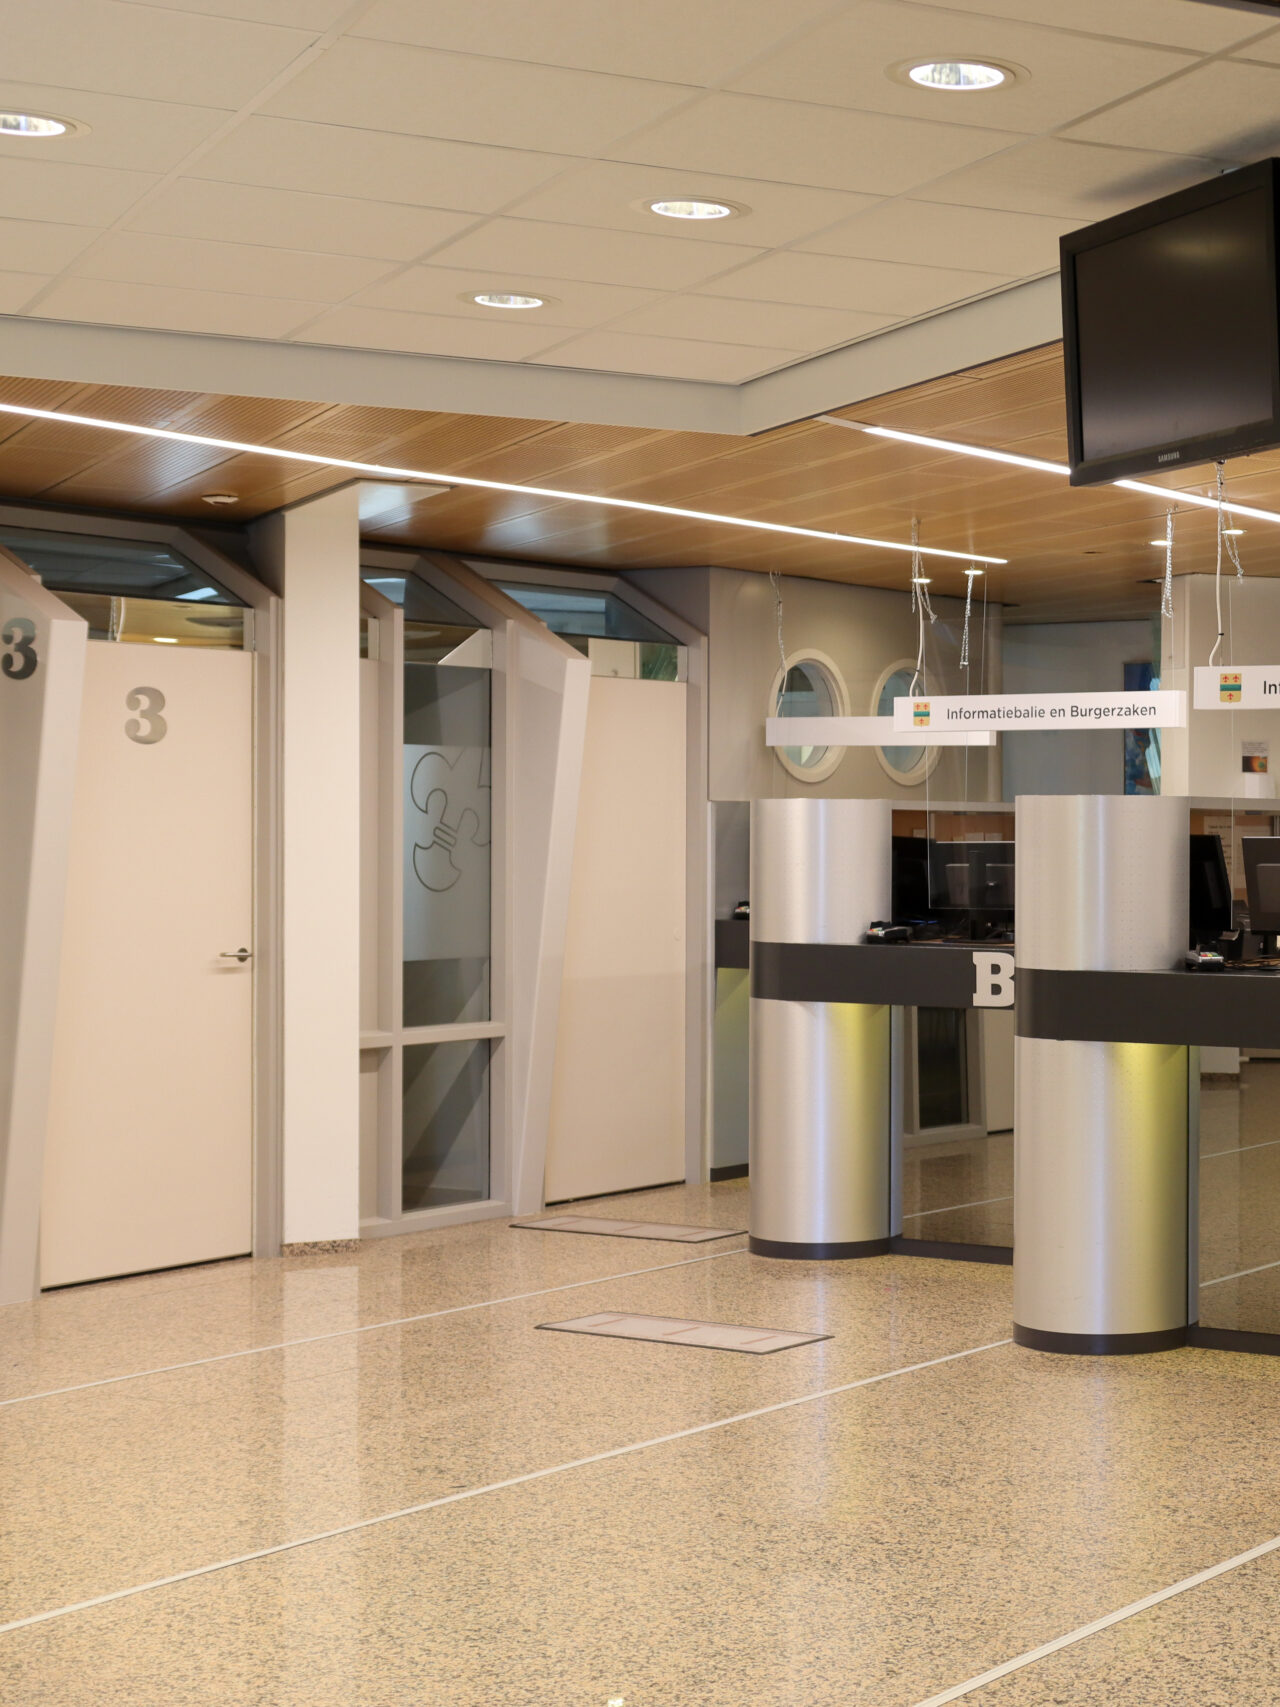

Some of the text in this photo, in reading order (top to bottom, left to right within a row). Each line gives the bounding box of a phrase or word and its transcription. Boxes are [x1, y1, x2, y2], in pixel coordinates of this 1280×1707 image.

[2, 617, 38, 680] 3
[125, 686, 168, 745] 3
[946, 704, 1157, 720] Informatiebalie en Burgerzaken
[972, 951, 1015, 1007] B
